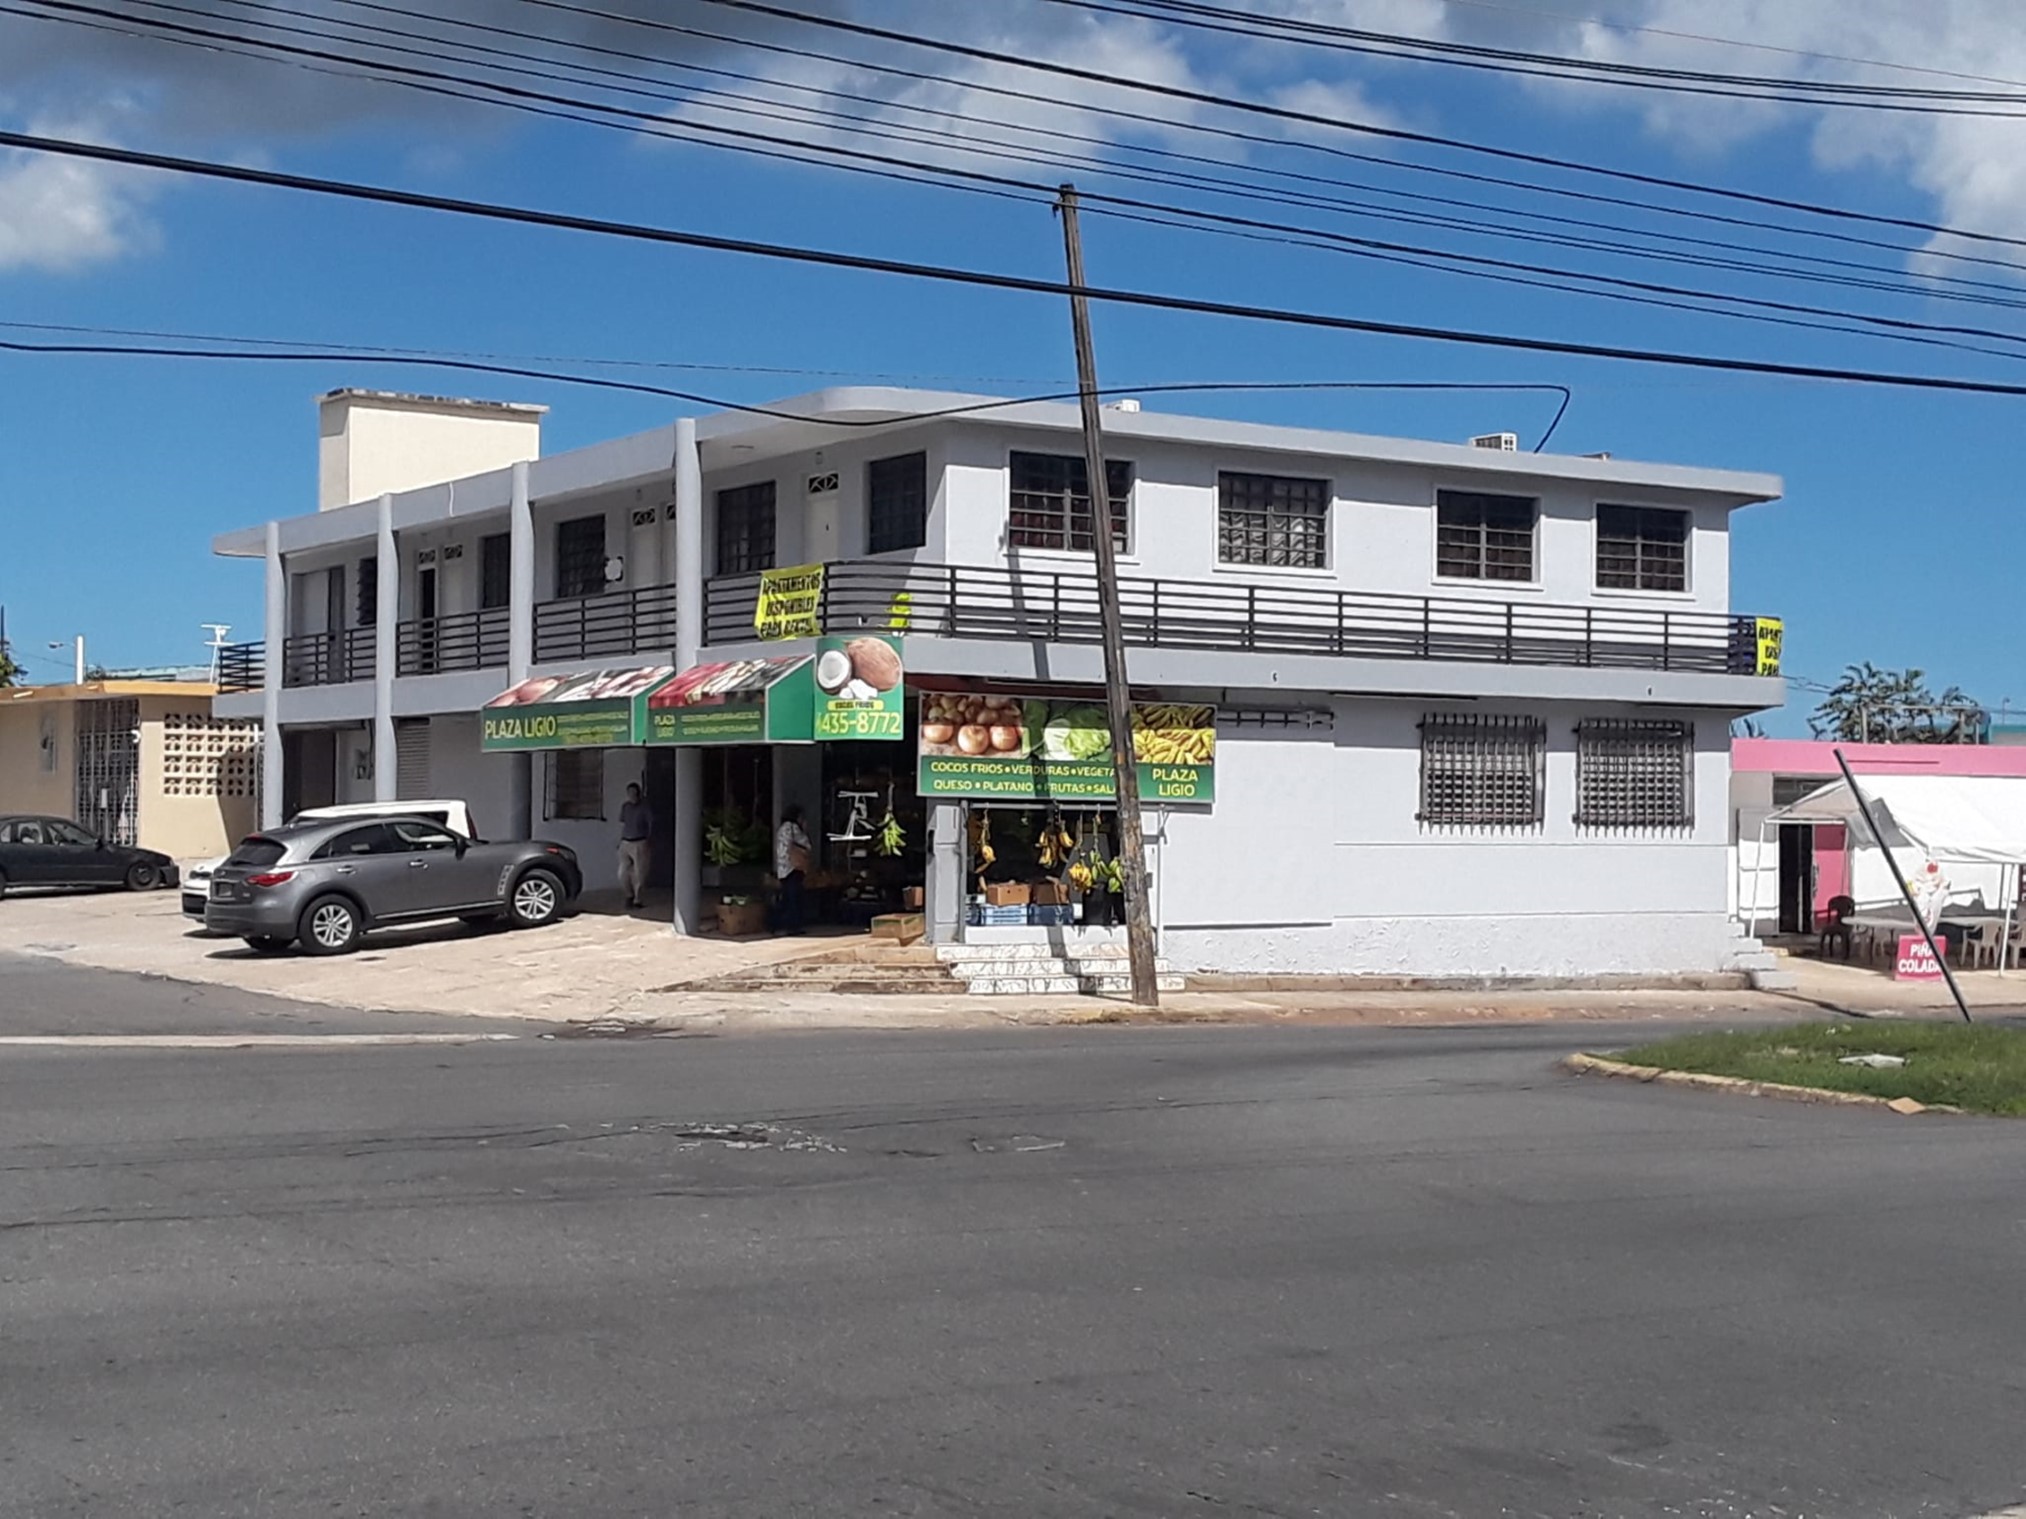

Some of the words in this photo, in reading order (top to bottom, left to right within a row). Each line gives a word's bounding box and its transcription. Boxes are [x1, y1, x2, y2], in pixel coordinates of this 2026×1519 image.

[484, 718, 523, 740] PLAZA
[524, 715, 557, 738] LIGIO
[930, 761, 969, 773] COCOS
[971, 762, 1004, 774] FRIOS
[1011, 763, 1070, 776] VERDURAS
[1076, 766, 1116, 777] VEGETA
[1152, 767, 1198, 782] PLAZA
[933, 779, 973, 791] QUESO
[982, 780, 1035, 792] PLATANO
[1043, 782, 1086, 793] FRUTAS
[1158, 783, 1196, 797] LIGIO
